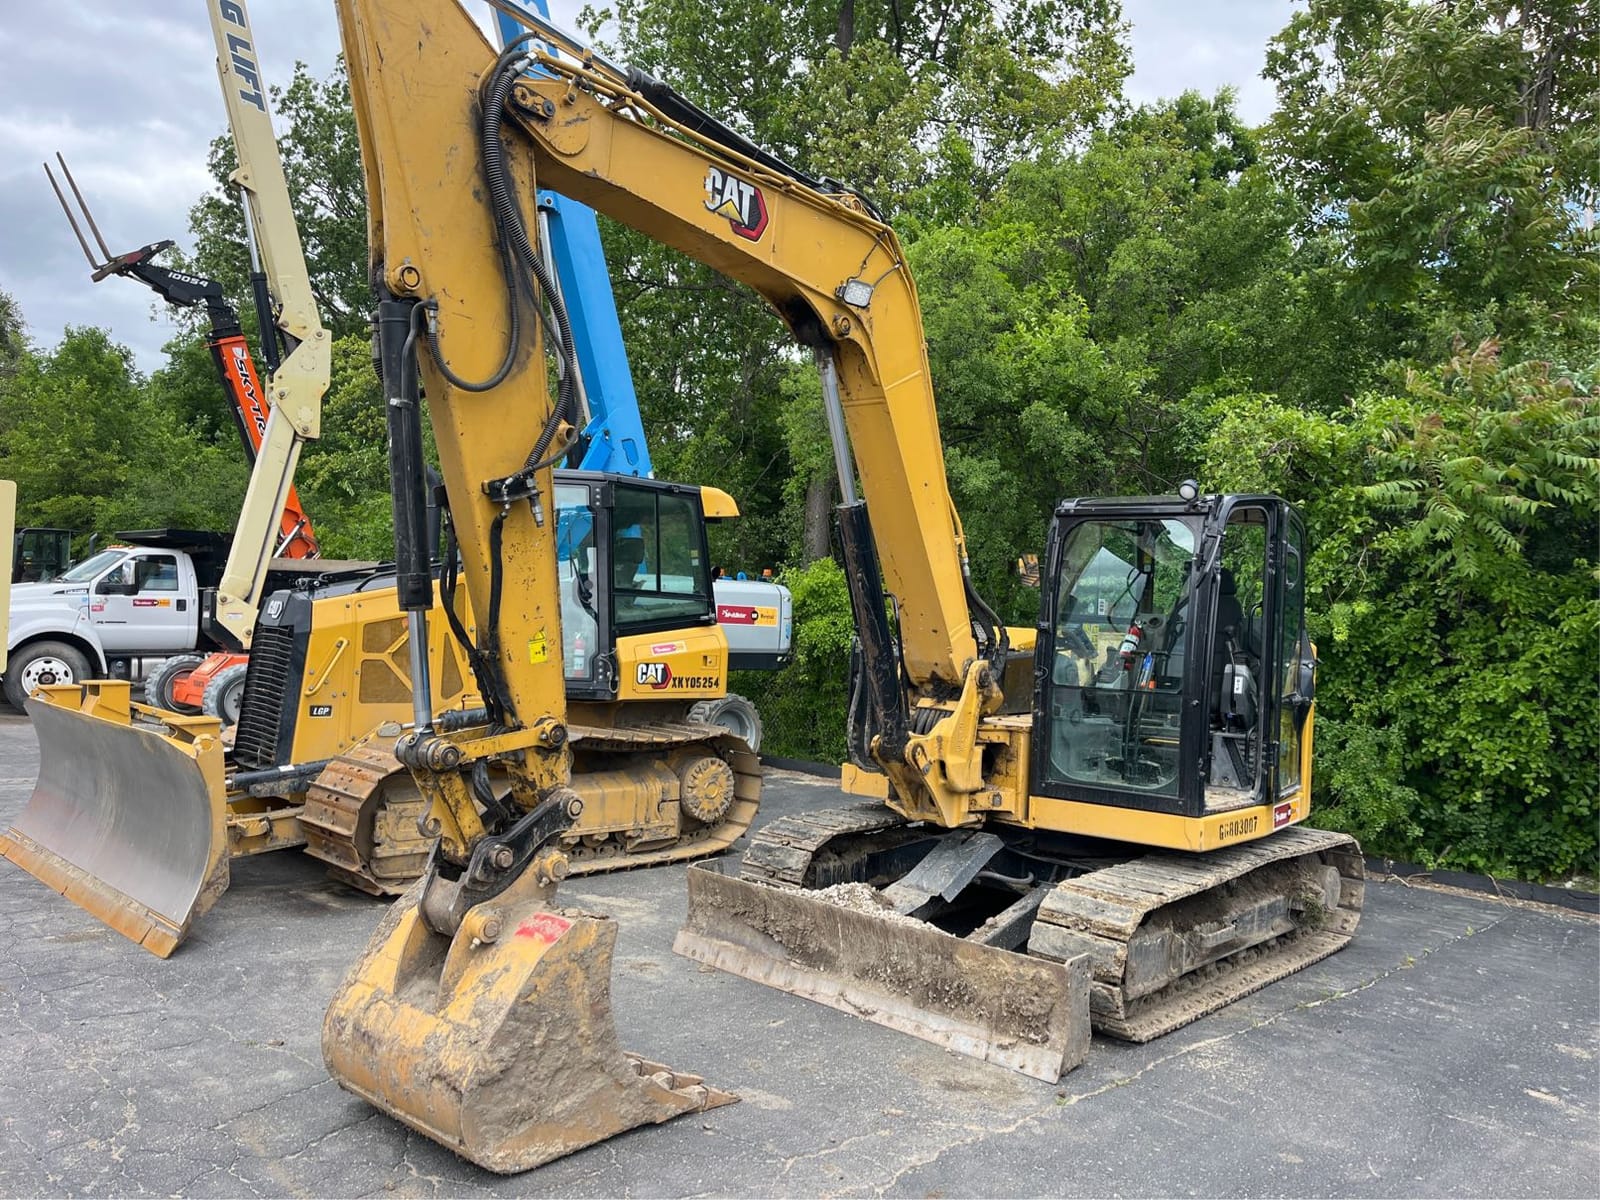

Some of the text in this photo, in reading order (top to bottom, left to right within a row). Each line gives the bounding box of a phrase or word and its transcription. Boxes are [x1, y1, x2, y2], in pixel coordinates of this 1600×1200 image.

[226, 33, 265, 112] LIFT
[705, 167, 755, 226] CAT
[637, 663, 665, 685] CAT
[671, 676, 719, 689] XKY05254
[313, 706, 330, 717] LGP
